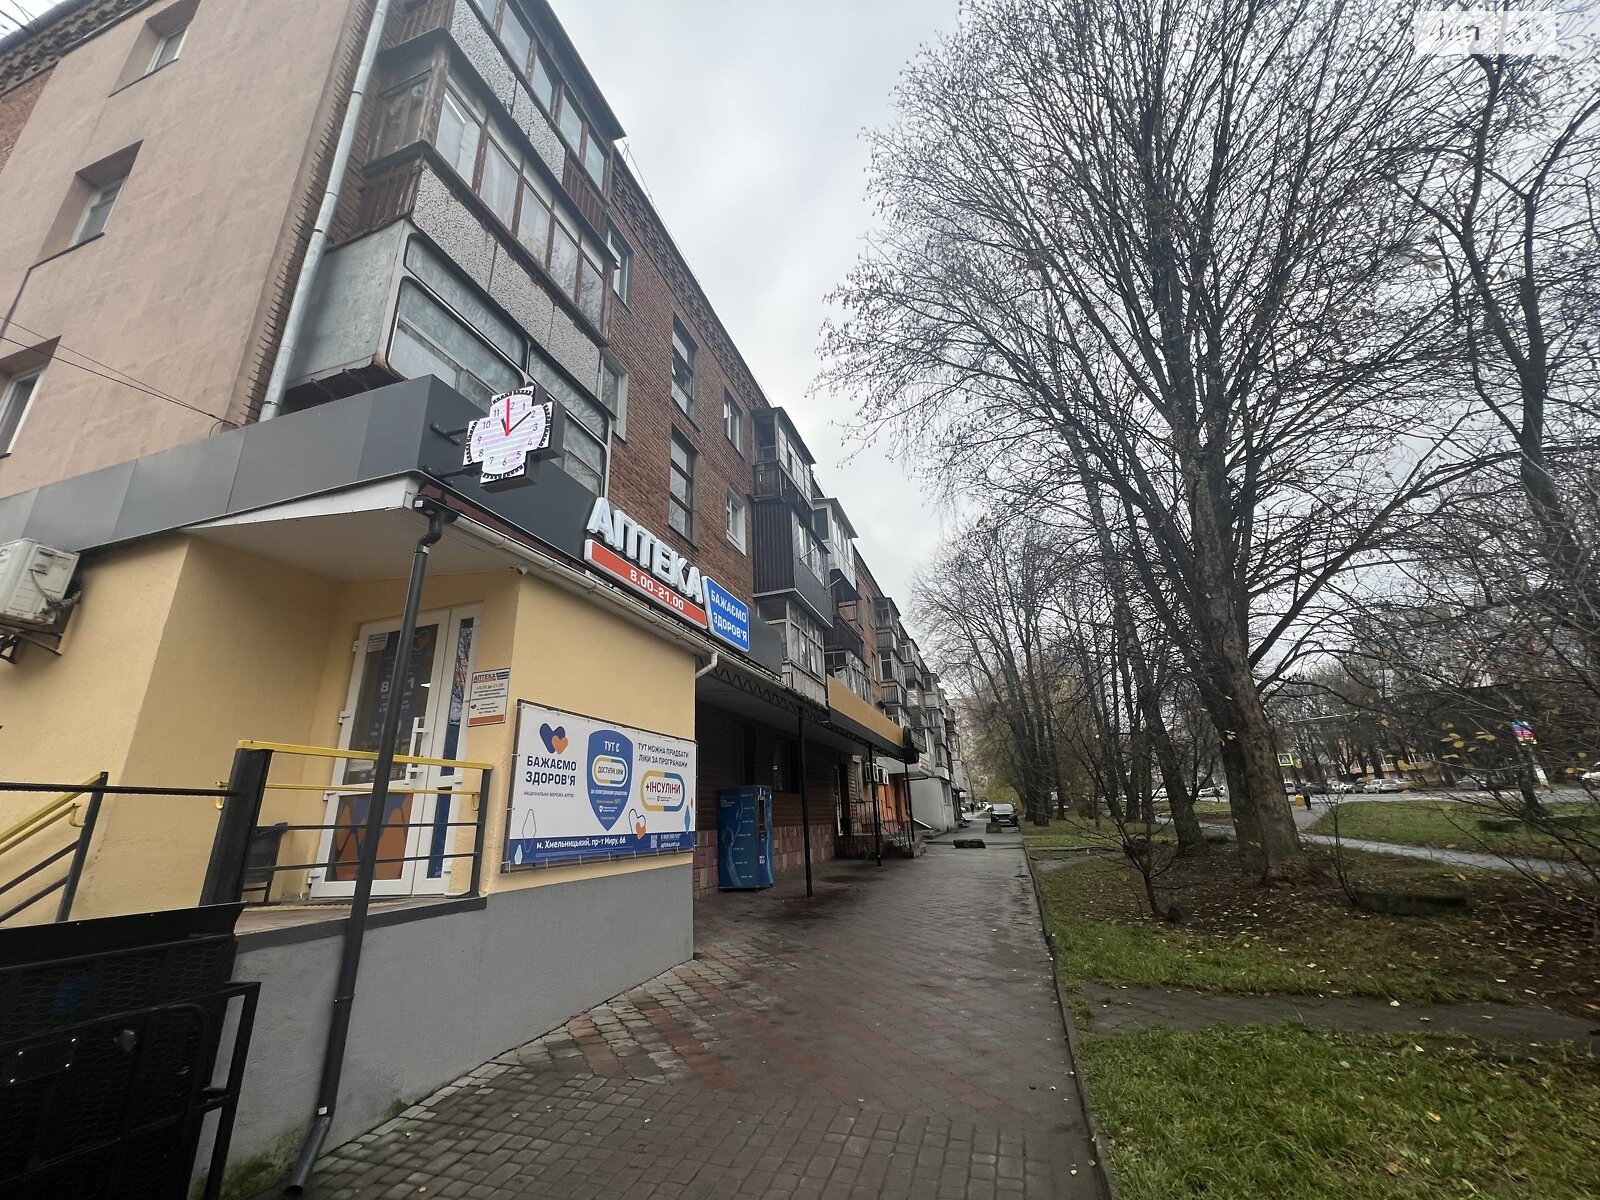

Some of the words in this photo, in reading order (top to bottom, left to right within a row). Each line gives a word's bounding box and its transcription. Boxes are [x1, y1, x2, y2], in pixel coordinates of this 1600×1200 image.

[493, 409, 500, 417] 11
[482, 420, 491, 429] 10
[533, 423, 539, 431] 3
[516, 450, 522, 459] 5
[501, 458, 507, 467] 6
[586, 497, 704, 605] АПТЕКА
[629, 568, 685, 612] 8.00-21.00
[710, 588, 747, 623] БАЖАЄМО
[713, 611, 748, 643] ЗДОРОВ'Я
[473, 673, 496, 681] АПТЕКА
[604, 741, 615, 752] ТУТ
[637, 742, 647, 751] ТУТ
[666, 748, 689, 758] ПРИДБАТИ
[526, 755, 577, 771] БАЖАЄМО
[525, 771, 576, 786] ЗДОРОВ'Я
[619, 836, 626, 844] 66
